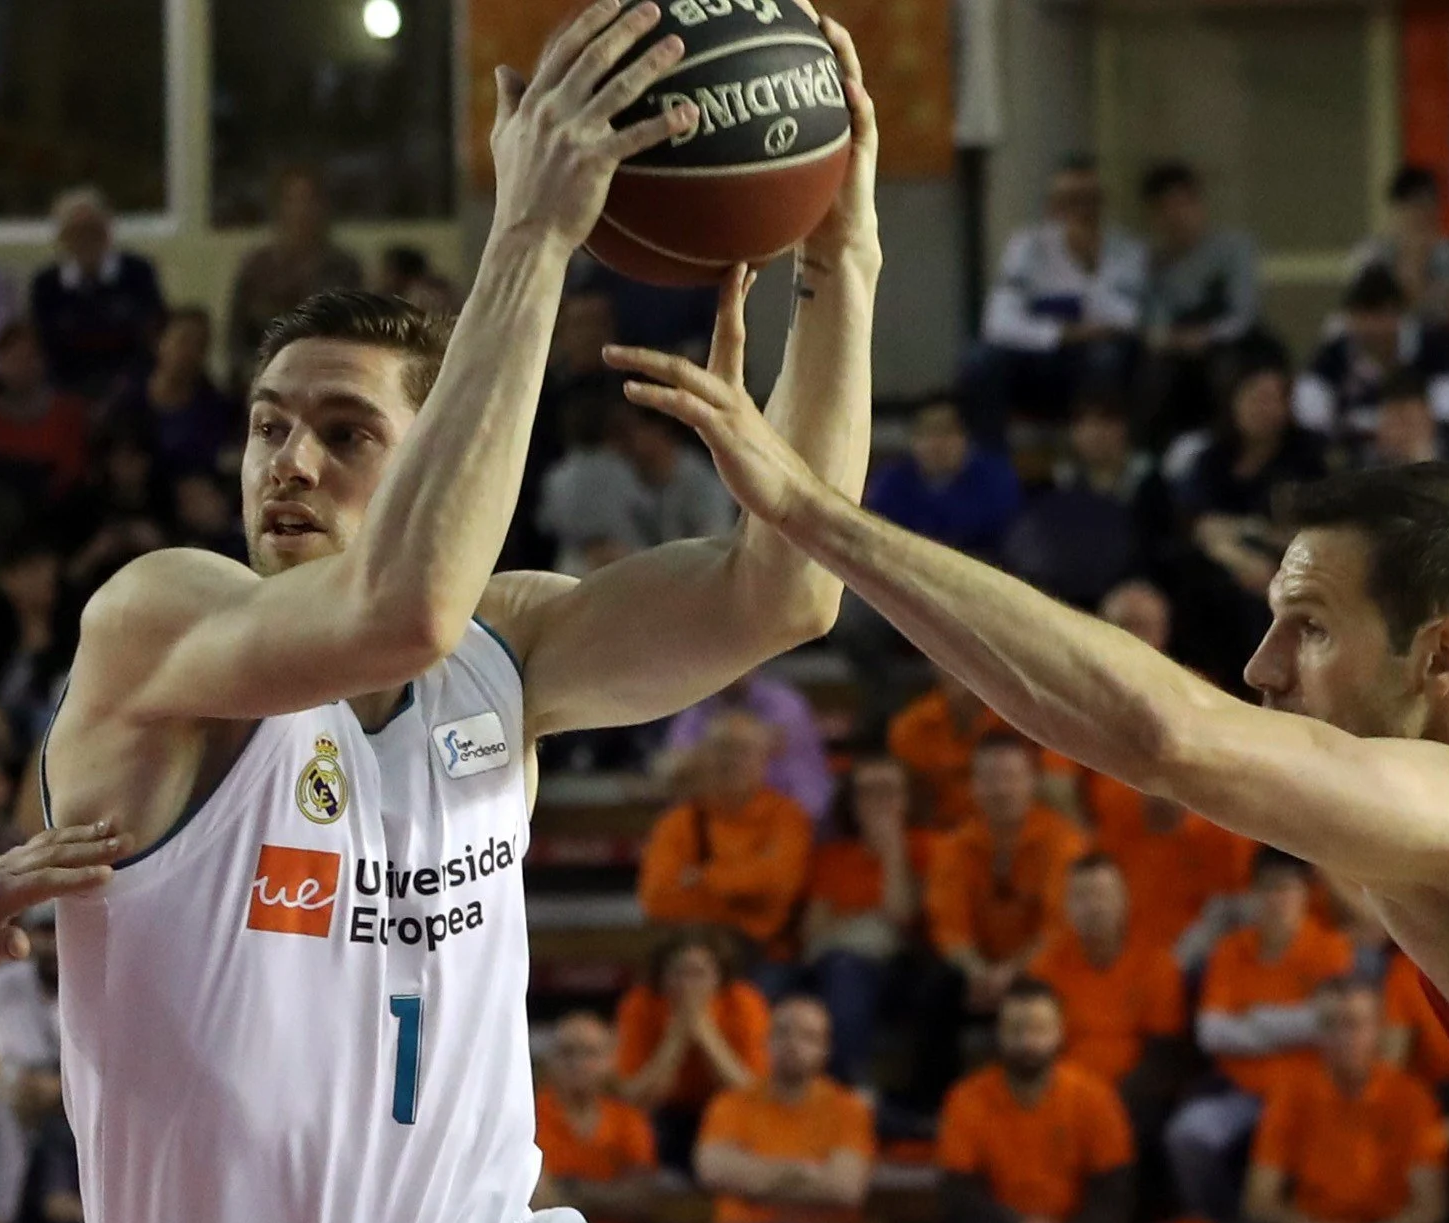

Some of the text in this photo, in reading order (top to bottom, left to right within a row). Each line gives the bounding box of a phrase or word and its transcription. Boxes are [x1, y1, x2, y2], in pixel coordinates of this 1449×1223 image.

[662, 56, 845, 146] SPALDING
[460, 742, 507, 762] endesa
[349, 900, 485, 953] Europea
[389, 993, 423, 1126] 1
